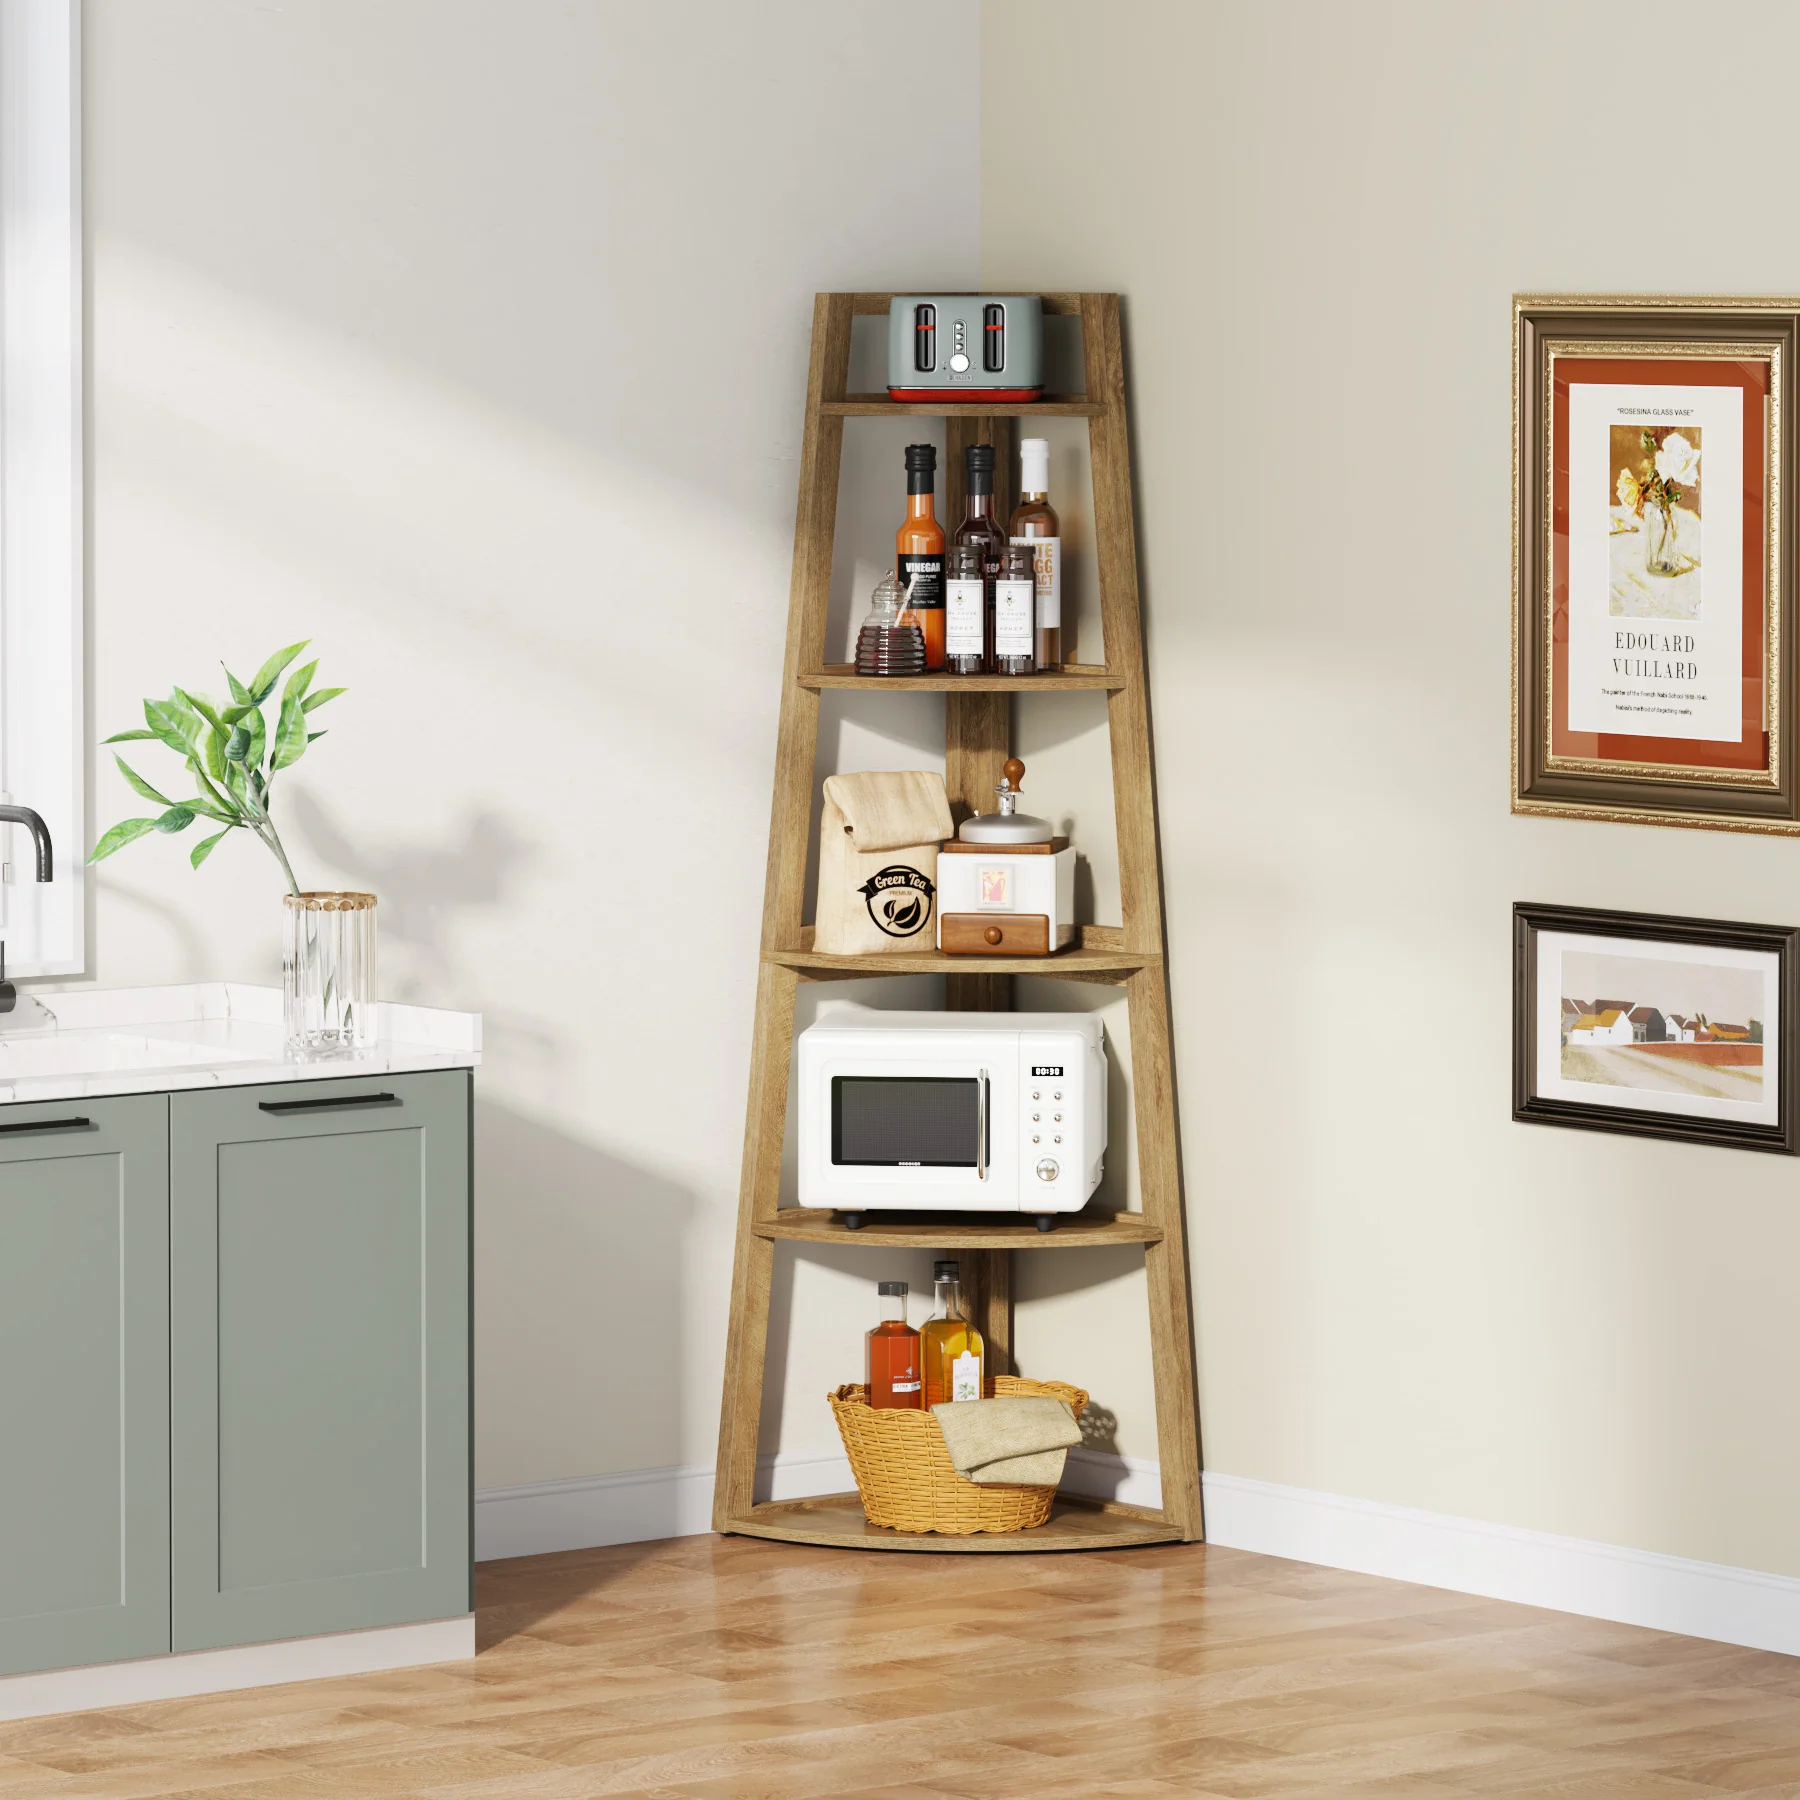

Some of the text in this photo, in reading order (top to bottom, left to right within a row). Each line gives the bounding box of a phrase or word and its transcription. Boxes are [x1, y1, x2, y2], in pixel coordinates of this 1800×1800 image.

[1652, 408, 1674, 416] GLASS
[1674, 408, 1694, 416] VASE"
[905, 562, 941, 573] VINEGAR
[1615, 631, 1695, 653] EDOUARD
[1613, 658, 1697, 680] VUILLARD
[1656, 707, 1677, 715] depicting
[874, 873, 927, 890] Green Tea
